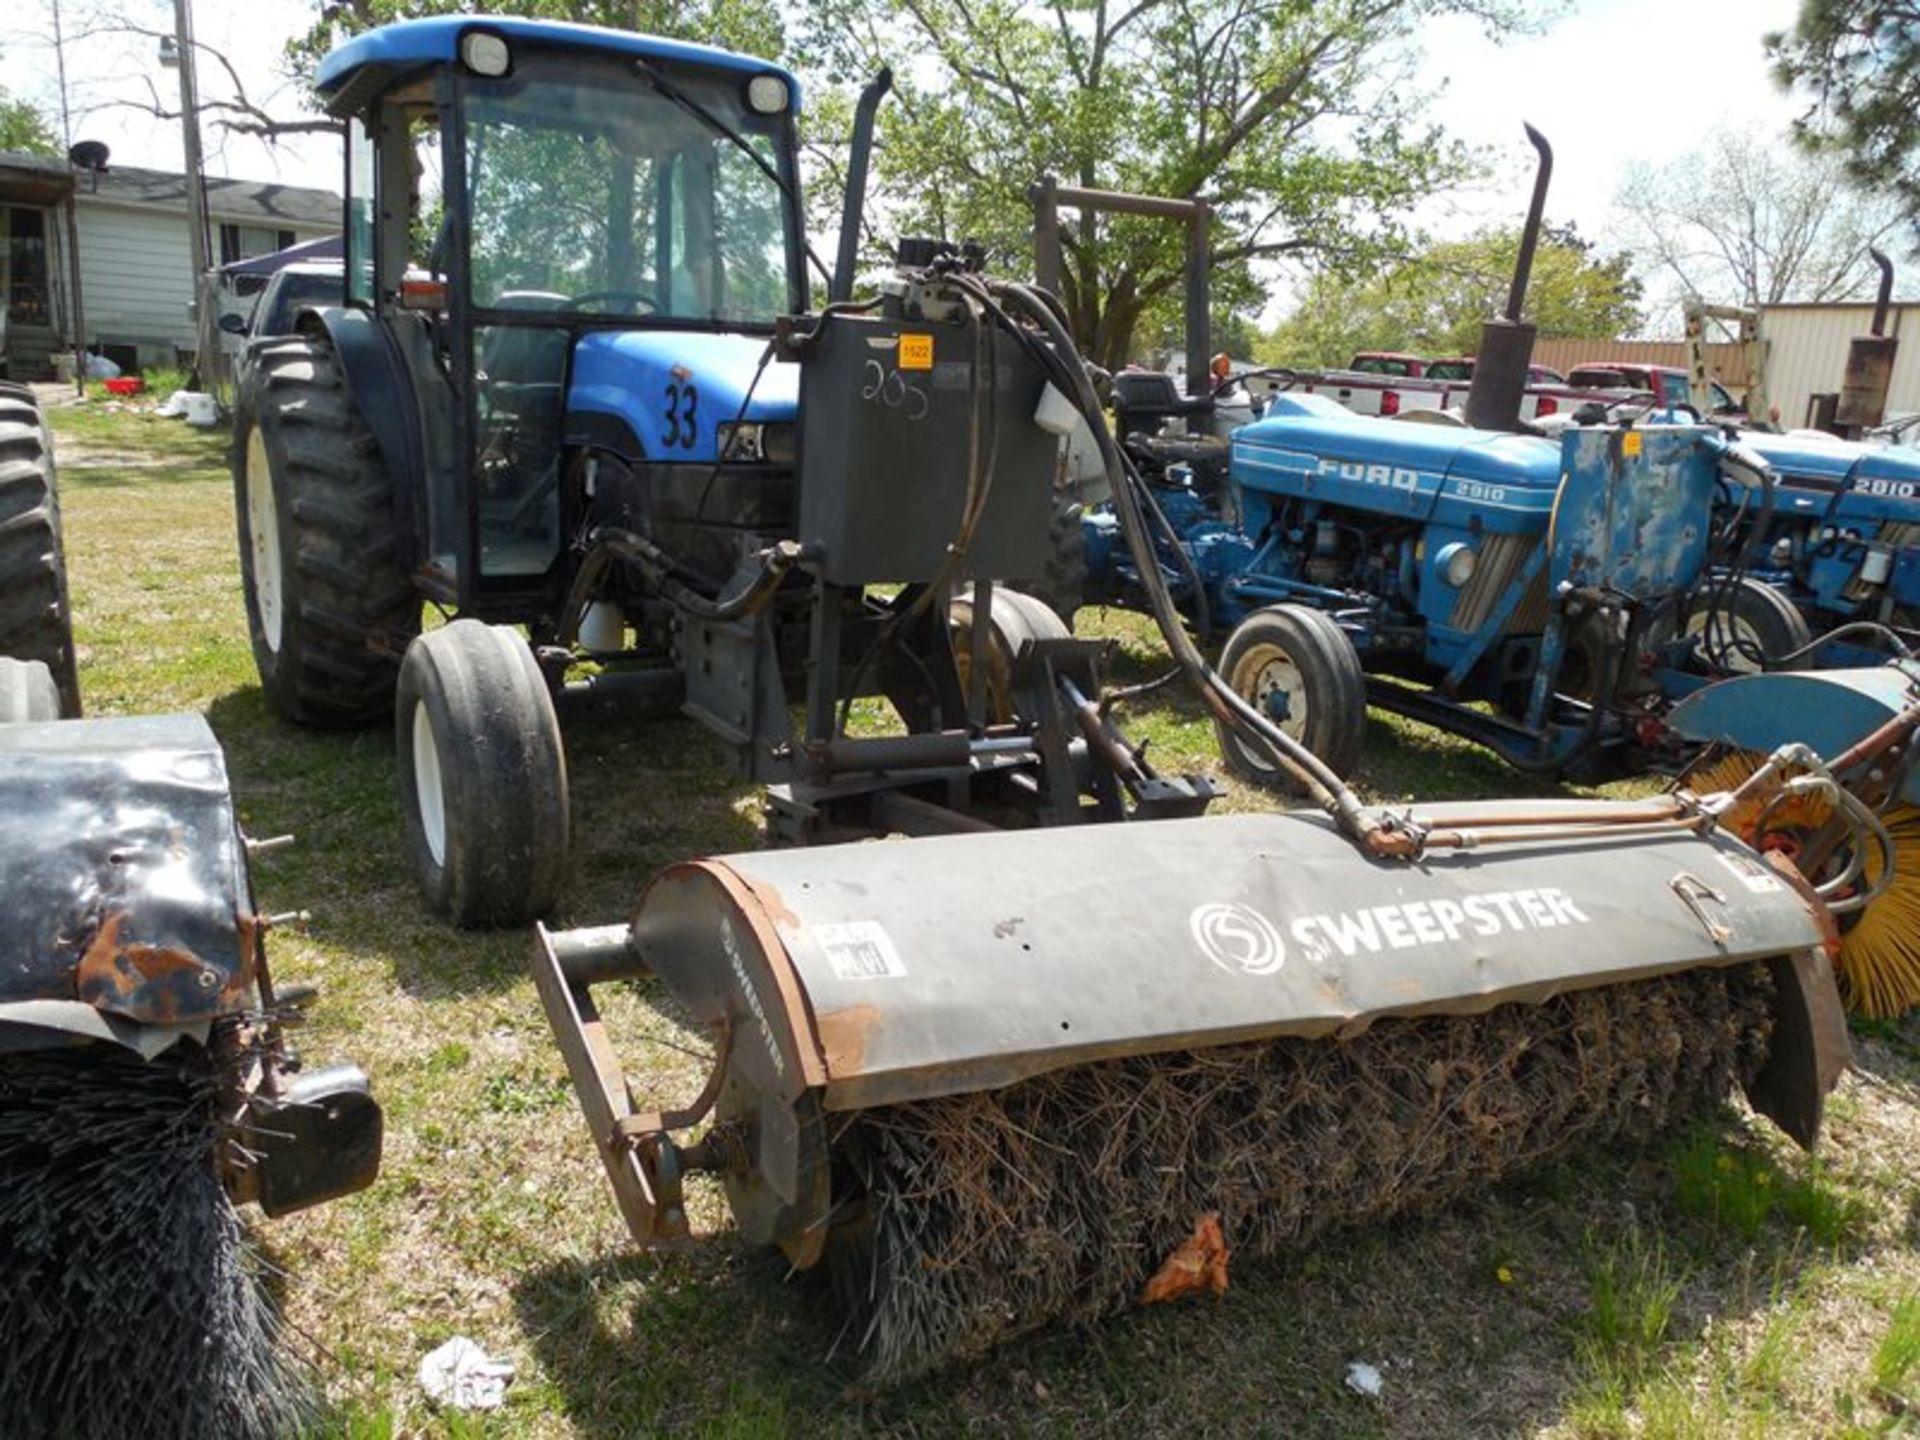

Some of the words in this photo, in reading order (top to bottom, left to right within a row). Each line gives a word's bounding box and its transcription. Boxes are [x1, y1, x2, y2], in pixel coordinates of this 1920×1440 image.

[661, 384, 698, 450] 33
[1317, 459, 1419, 491] FORD
[1456, 480, 1505, 501] 2910
[1854, 478, 1915, 497] 2810
[1291, 887, 1591, 962] SWEEPSTER
